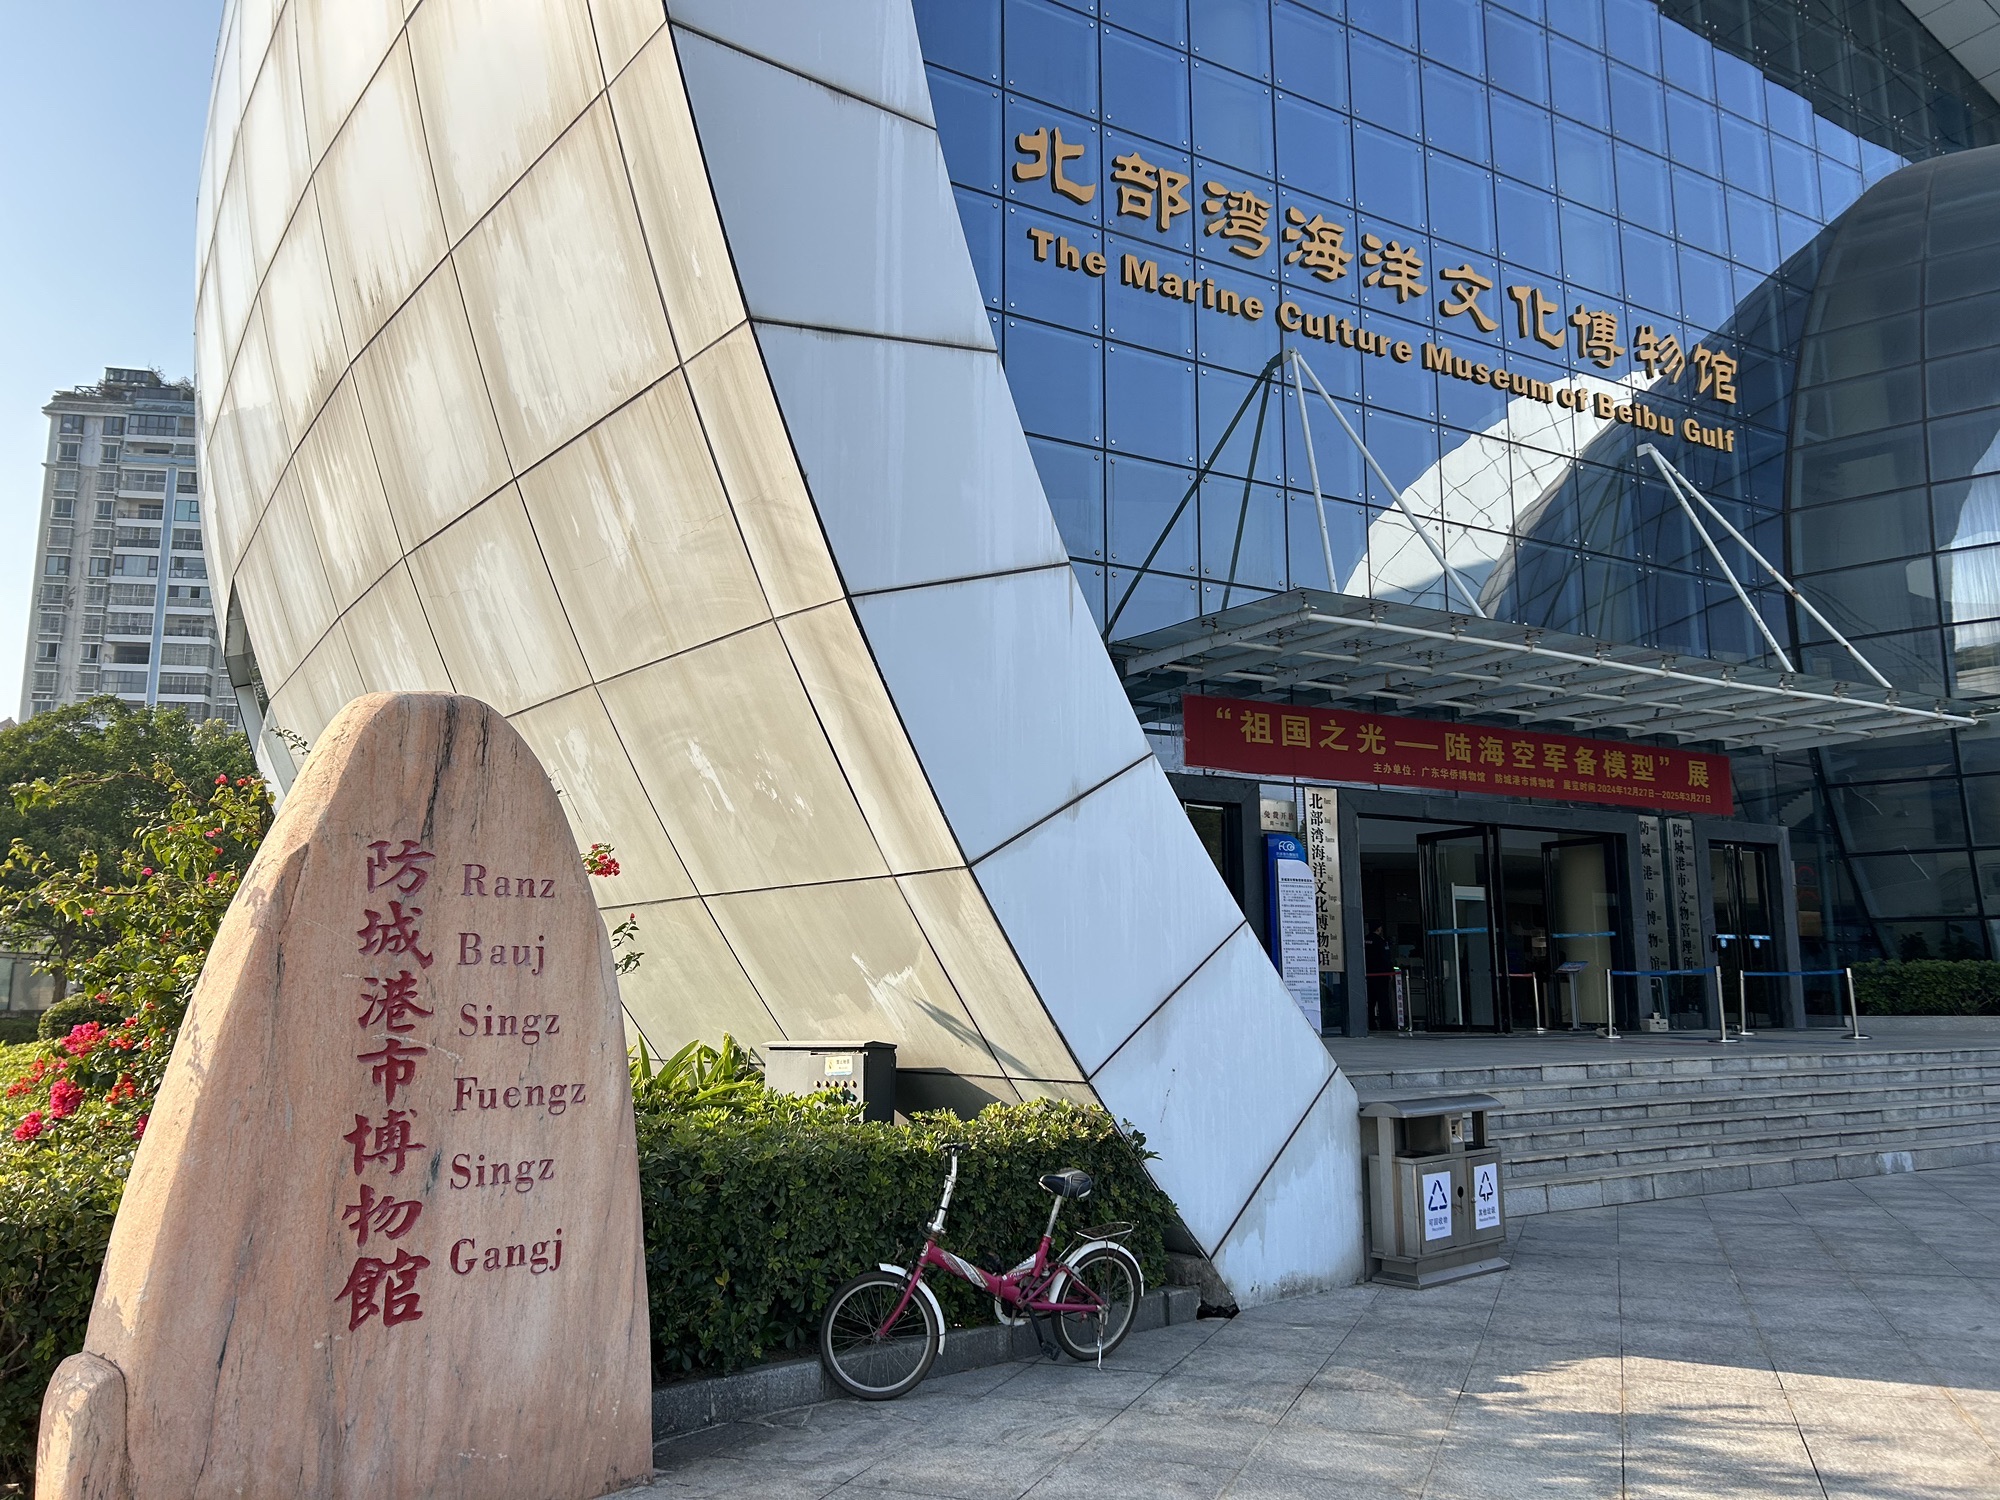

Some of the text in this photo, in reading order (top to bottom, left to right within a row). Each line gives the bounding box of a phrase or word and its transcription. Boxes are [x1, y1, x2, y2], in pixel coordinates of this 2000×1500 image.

[1012, 126, 1738, 405] 北部湾海洋文化博物馆
[1028, 227, 1735, 453] The Marine Culture Museum of Beibu Gulf
[1494, 773, 1555, 789] 防城港市博物馆
[1687, 760, 1710, 789] 展
[1263, 810, 1294, 821] 免费开放
[460, 863, 556, 899] Ranz
[1309, 792, 1331, 967] 北部湾海洋文化博物馆
[1639, 820, 1661, 971] 防城港市博物馆
[1672, 823, 1693, 970] 防城港市文物管理所
[457, 932, 545, 976] Bauj
[458, 1002, 560, 1046] Singz
[335, 839, 435, 1333] 防城港市博物館
[451, 1076, 586, 1116] Fuengz
[450, 1153, 555, 1194] Singz
[450, 1228, 563, 1276] Gangj
